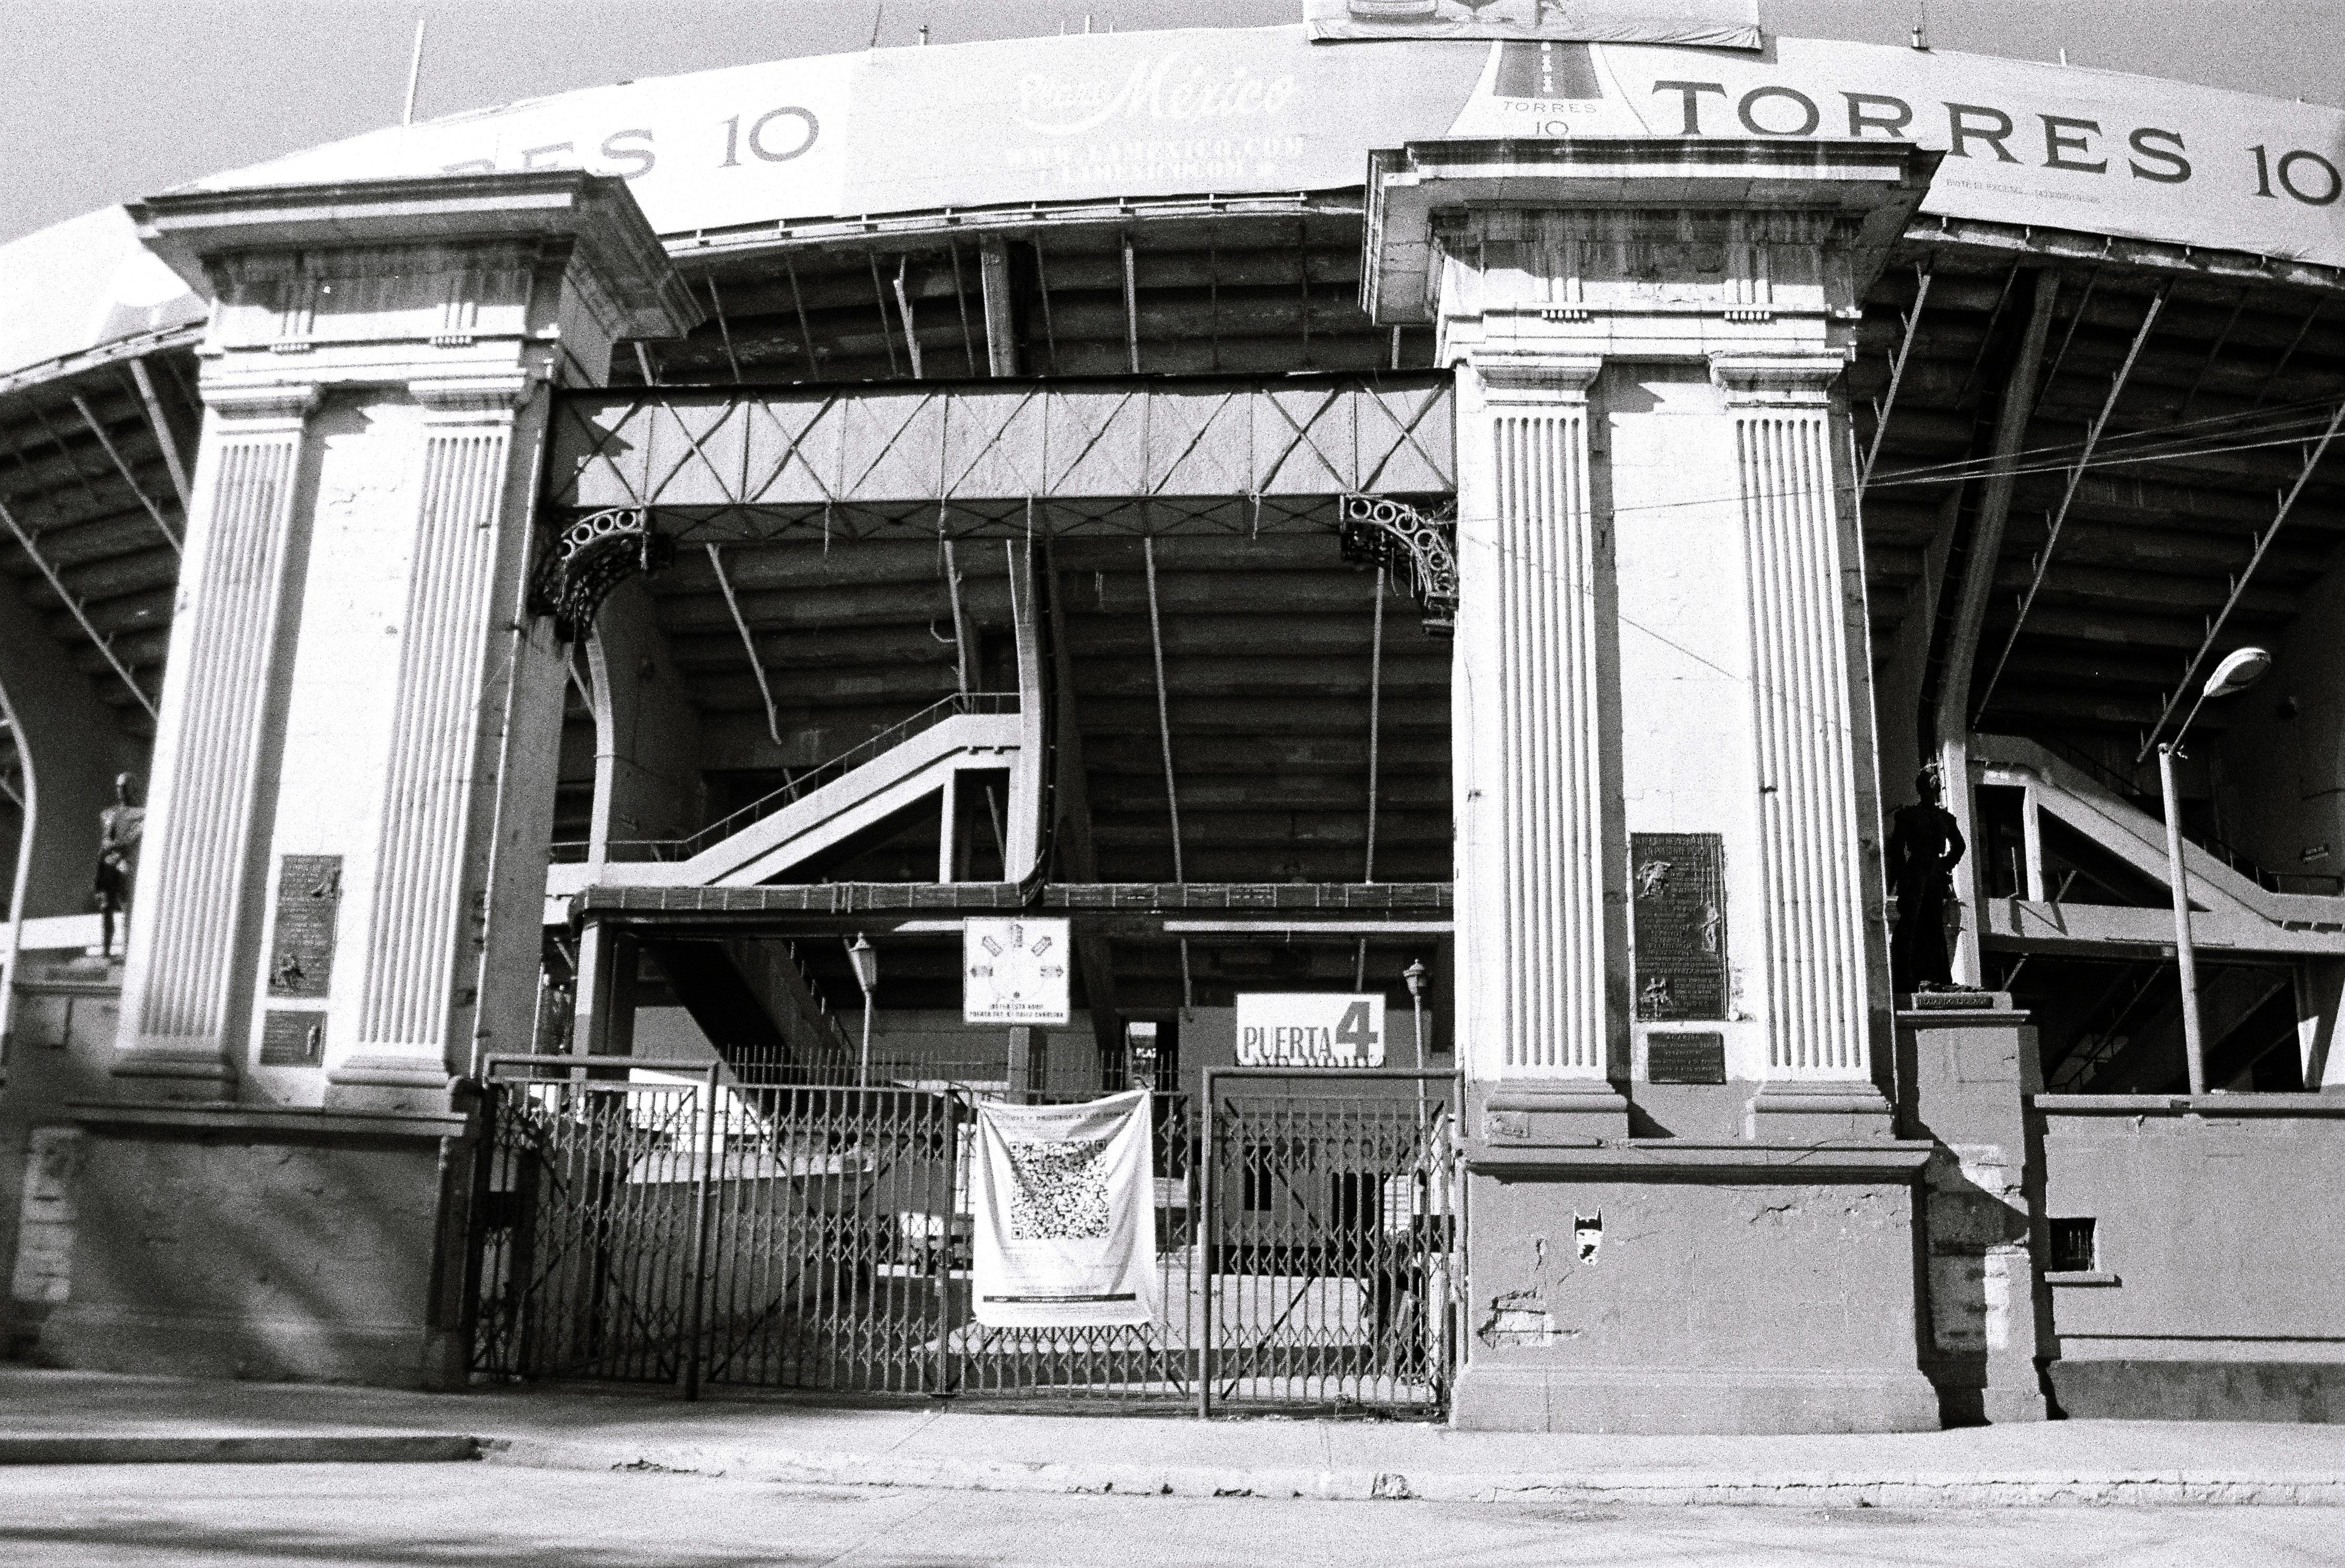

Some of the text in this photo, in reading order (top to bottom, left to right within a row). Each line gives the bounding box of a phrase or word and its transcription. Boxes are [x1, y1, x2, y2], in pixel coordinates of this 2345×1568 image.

[1077, 51, 1298, 130] México
[1503, 100, 1598, 114] TORRES
[716, 106, 820, 168] 10
[1535, 120, 1570, 136] 10
[1651, 79, 2343, 206] TORRES 10
[1243, 1001, 1379, 1059] PUERTA 4
